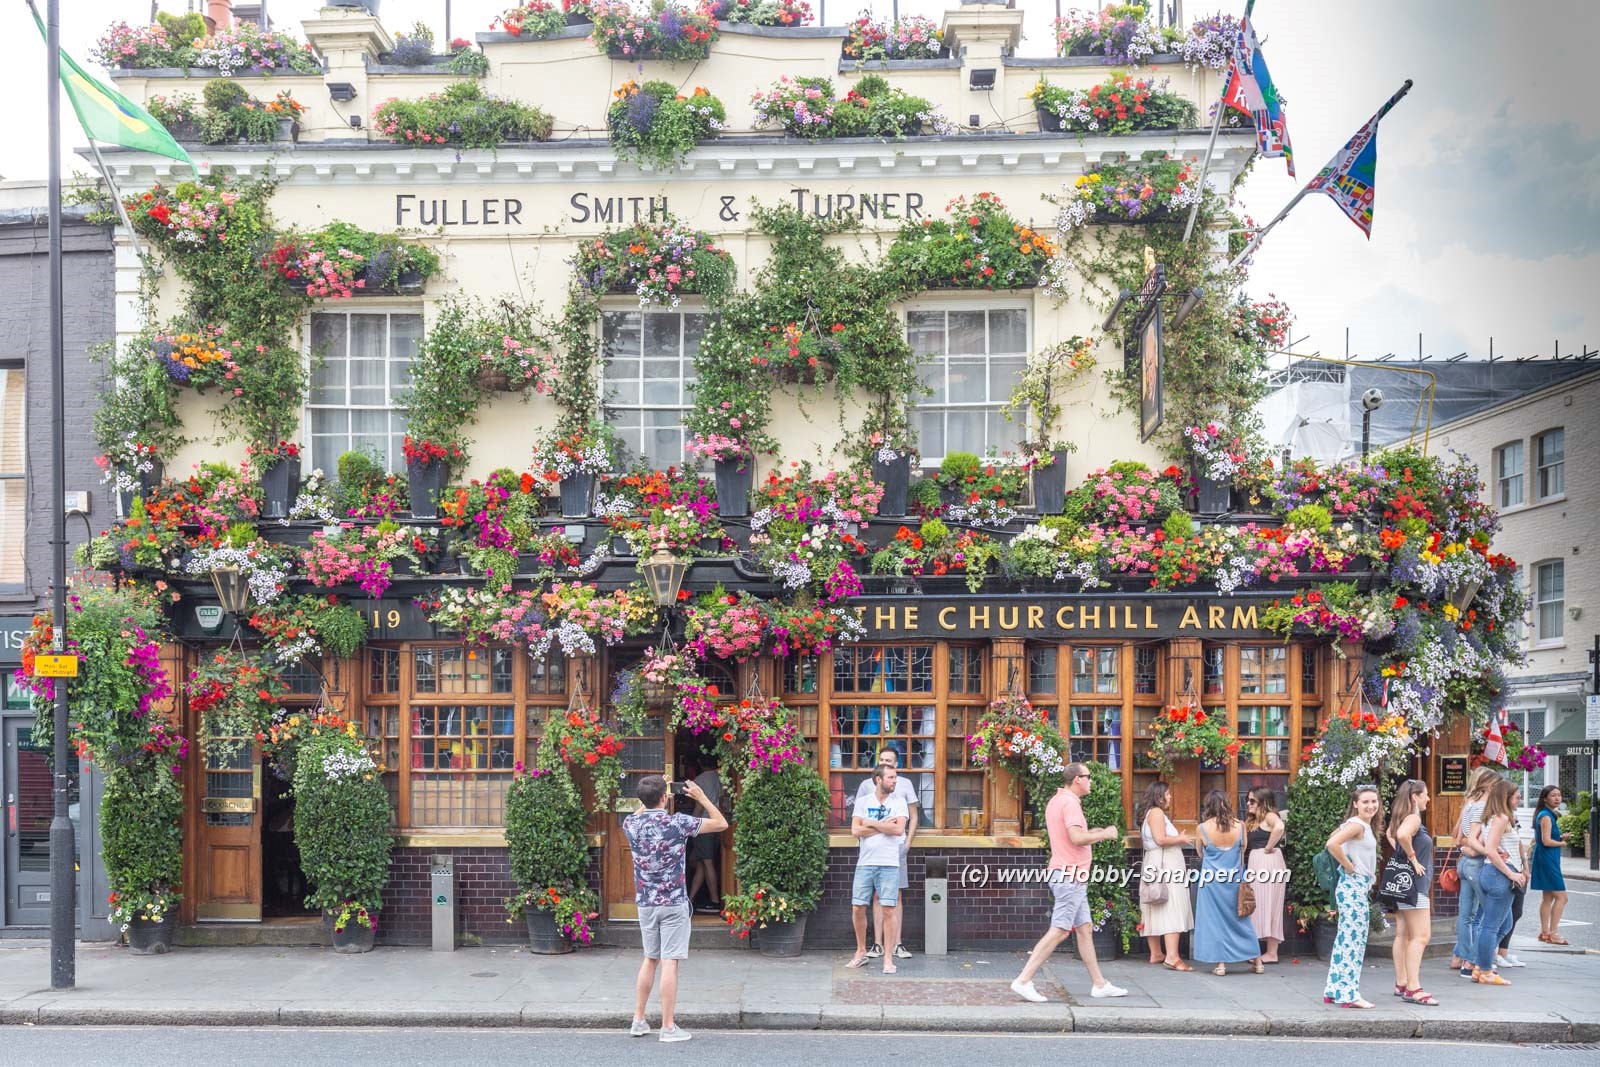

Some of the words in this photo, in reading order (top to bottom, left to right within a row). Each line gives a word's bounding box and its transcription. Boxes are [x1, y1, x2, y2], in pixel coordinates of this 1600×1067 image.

[396, 194, 522, 226] FULLER
[570, 192, 668, 224] SMITH
[719, 195, 741, 222] &
[938, 605, 1159, 630] CHURCHILL
[1178, 605, 1276, 630] ARM
[1385, 881, 1402, 893] SBL
[1396, 875, 1409, 884] 30
